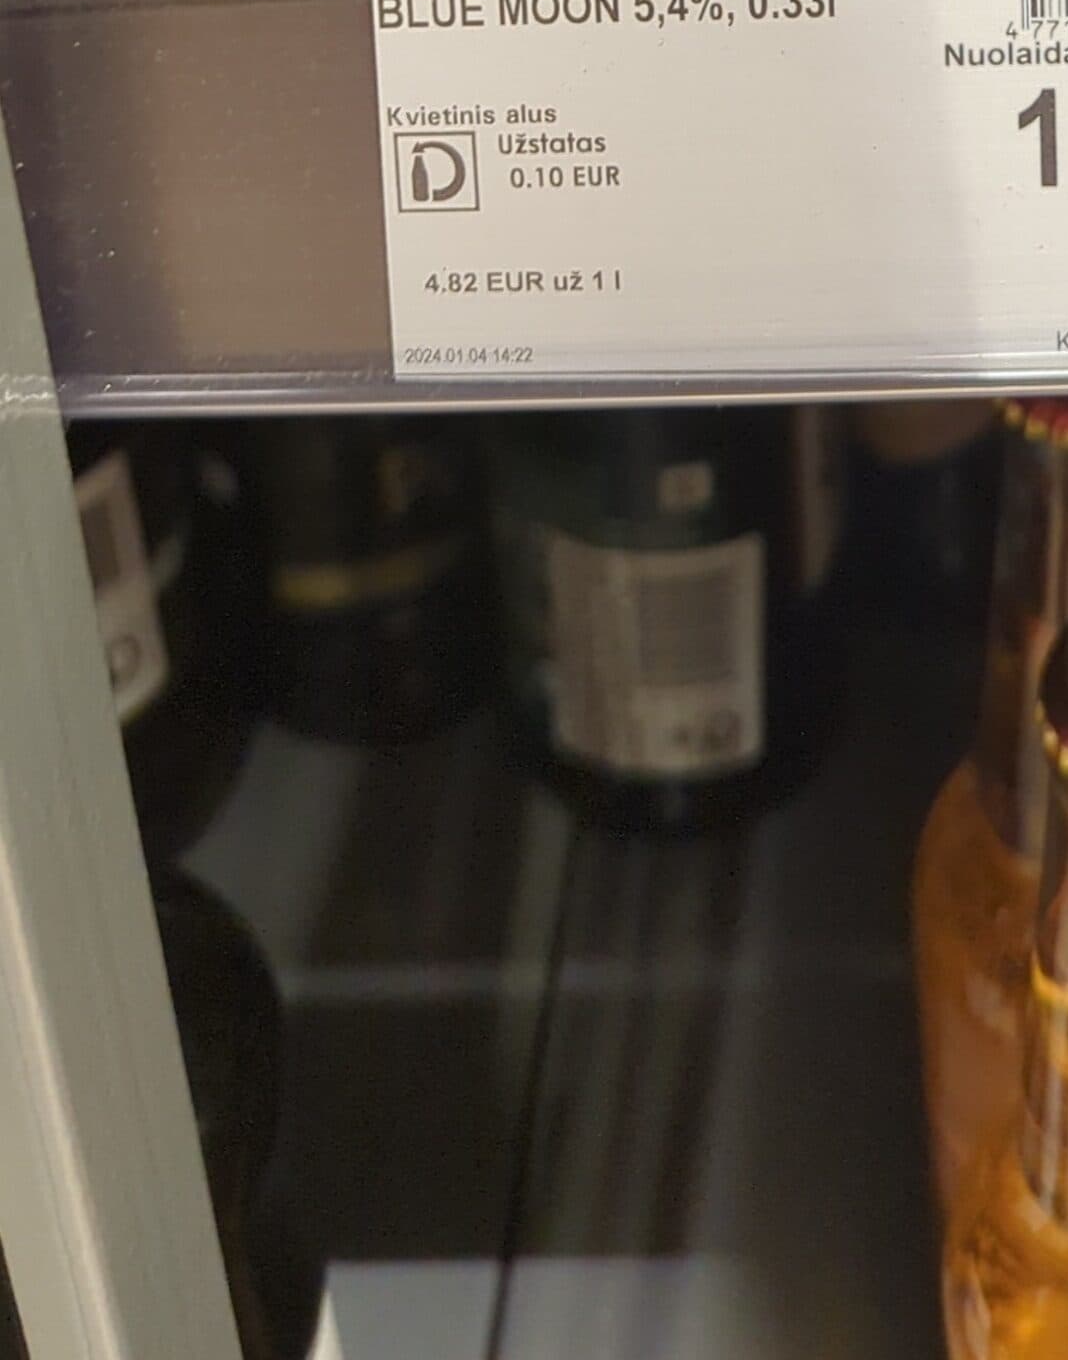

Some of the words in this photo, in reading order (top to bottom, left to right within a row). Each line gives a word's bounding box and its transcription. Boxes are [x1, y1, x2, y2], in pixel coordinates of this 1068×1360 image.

[386, 104, 496, 127] Kvietinis
[505, 104, 558, 124] alus
[498, 131, 607, 156] Užstatas
[1018, 87, 1058, 187] 1
[509, 166, 565, 190] 0.10
[573, 165, 621, 188] EUR
[486, 270, 545, 293] EUR
[553, 270, 584, 292] už
[592, 270, 603, 291] 1
[404, 347, 488, 364] 2024.01.04
[492, 346, 534, 363] 14:22
